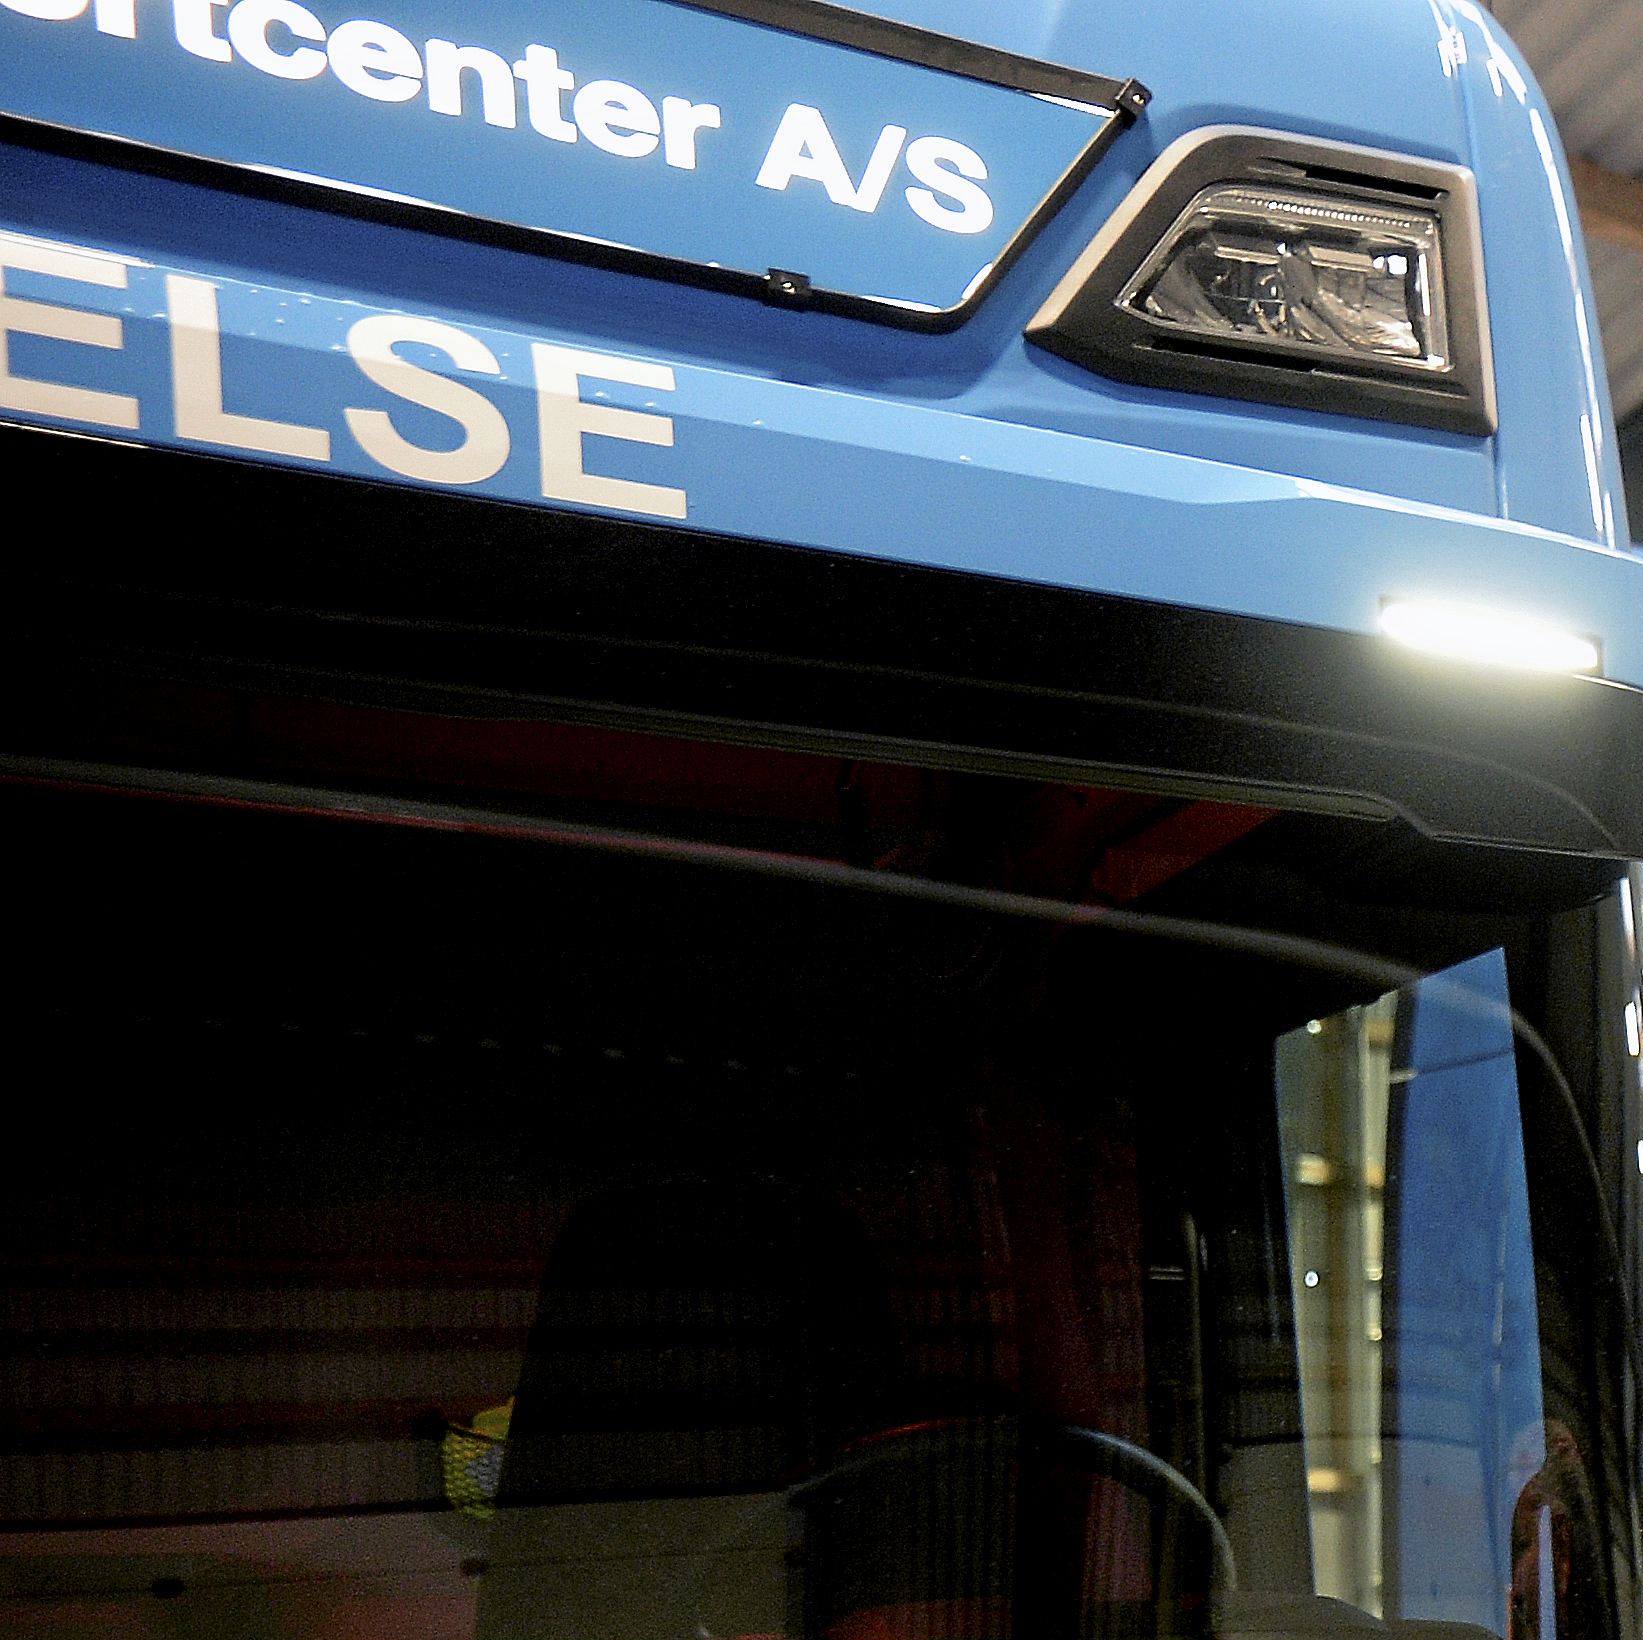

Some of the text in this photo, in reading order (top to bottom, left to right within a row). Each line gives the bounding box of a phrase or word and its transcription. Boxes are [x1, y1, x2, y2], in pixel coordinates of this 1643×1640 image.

[0, 0, 994, 234] rtcenter A/S
[0, 232, 688, 519] ELSE
